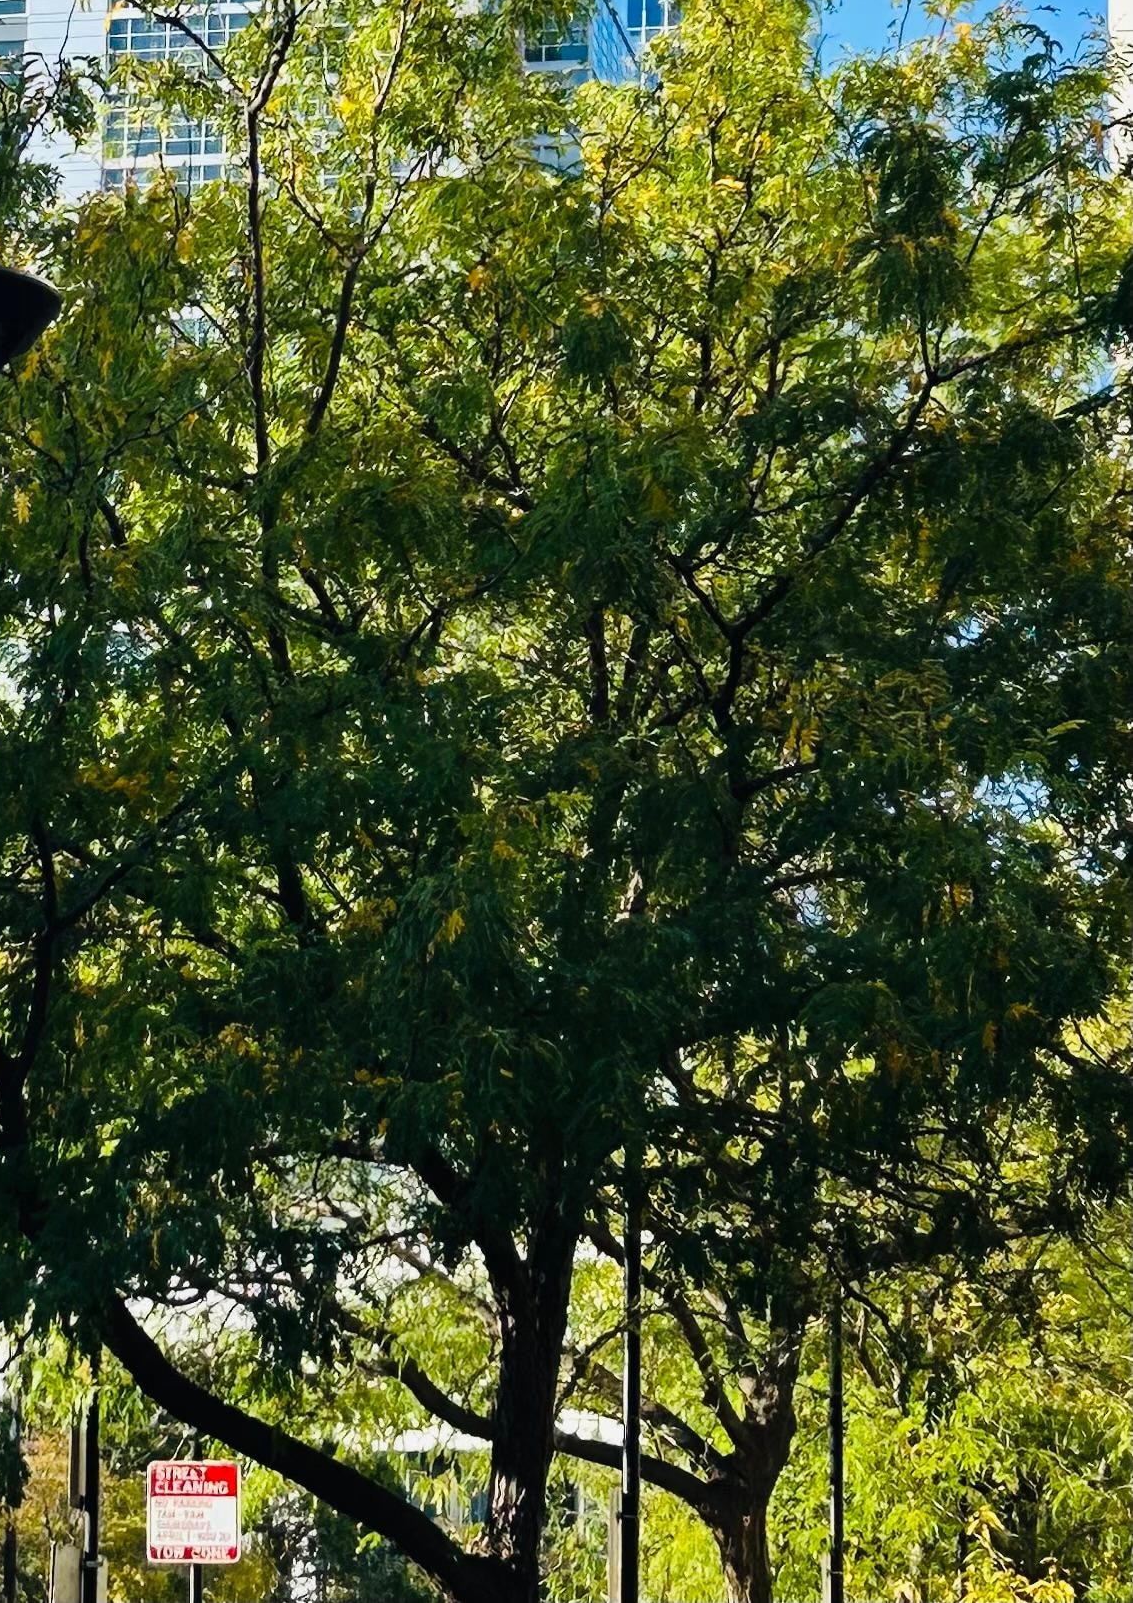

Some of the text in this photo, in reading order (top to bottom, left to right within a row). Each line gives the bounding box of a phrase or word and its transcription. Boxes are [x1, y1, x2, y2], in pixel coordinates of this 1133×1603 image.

[155, 1465, 207, 1480] STREET
[154, 1480, 229, 1494] CLEANING
[156, 1547, 185, 1559] TOW
